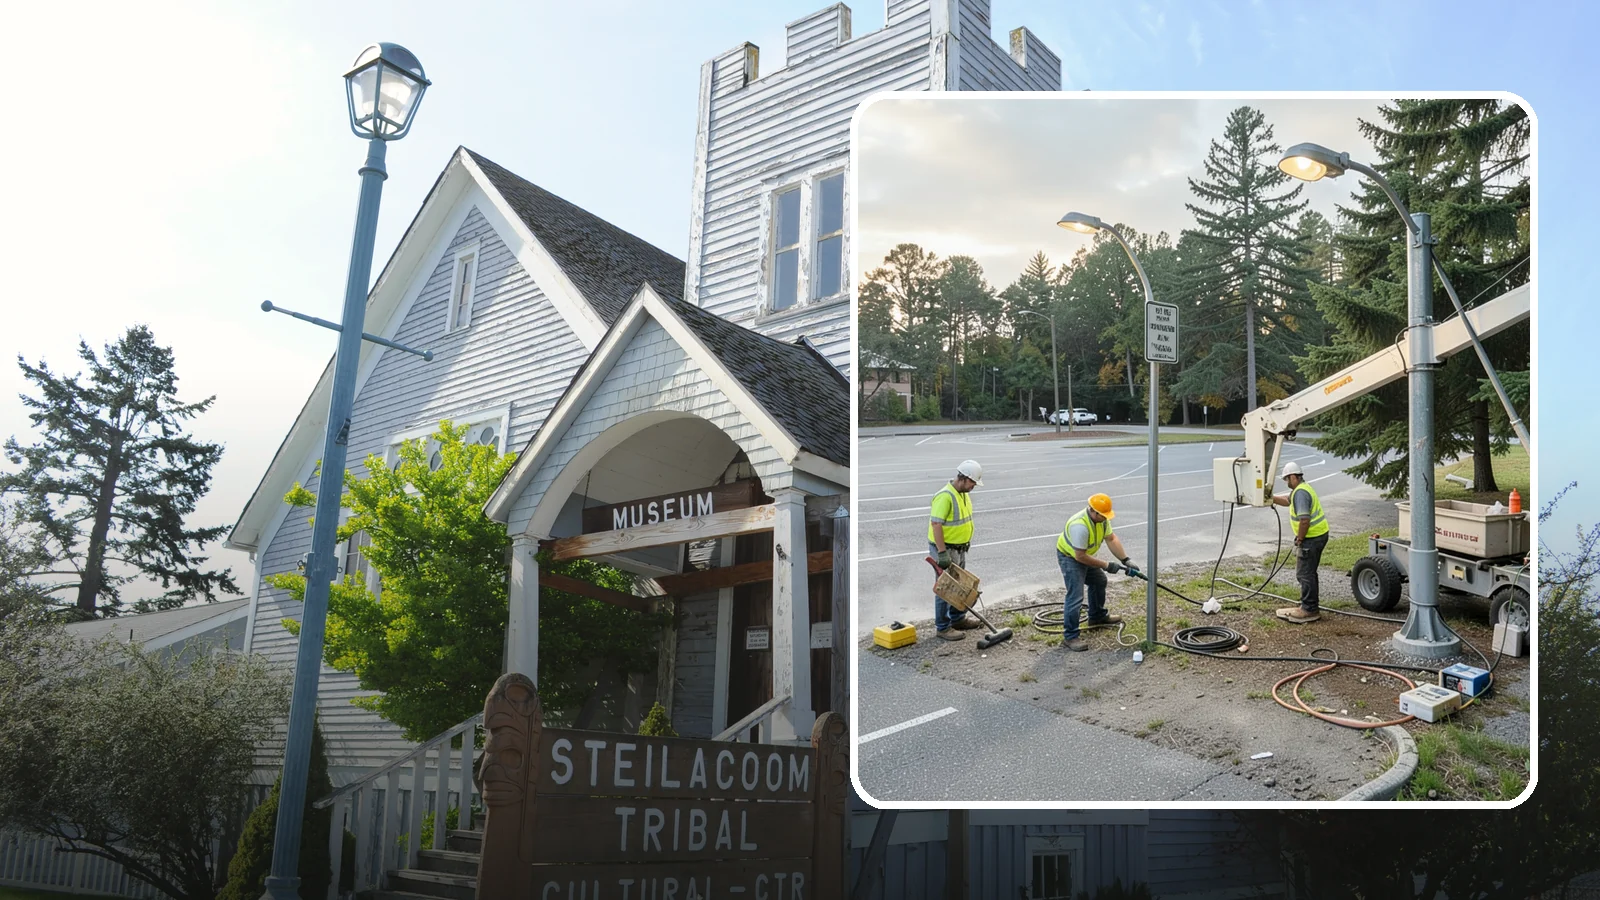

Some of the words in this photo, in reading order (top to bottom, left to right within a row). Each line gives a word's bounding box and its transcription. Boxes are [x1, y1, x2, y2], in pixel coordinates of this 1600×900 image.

[612, 491, 714, 530] MUSEUM
[550, 738, 810, 792] STEILACOOM
[615, 806, 758, 852] TRIBAL
